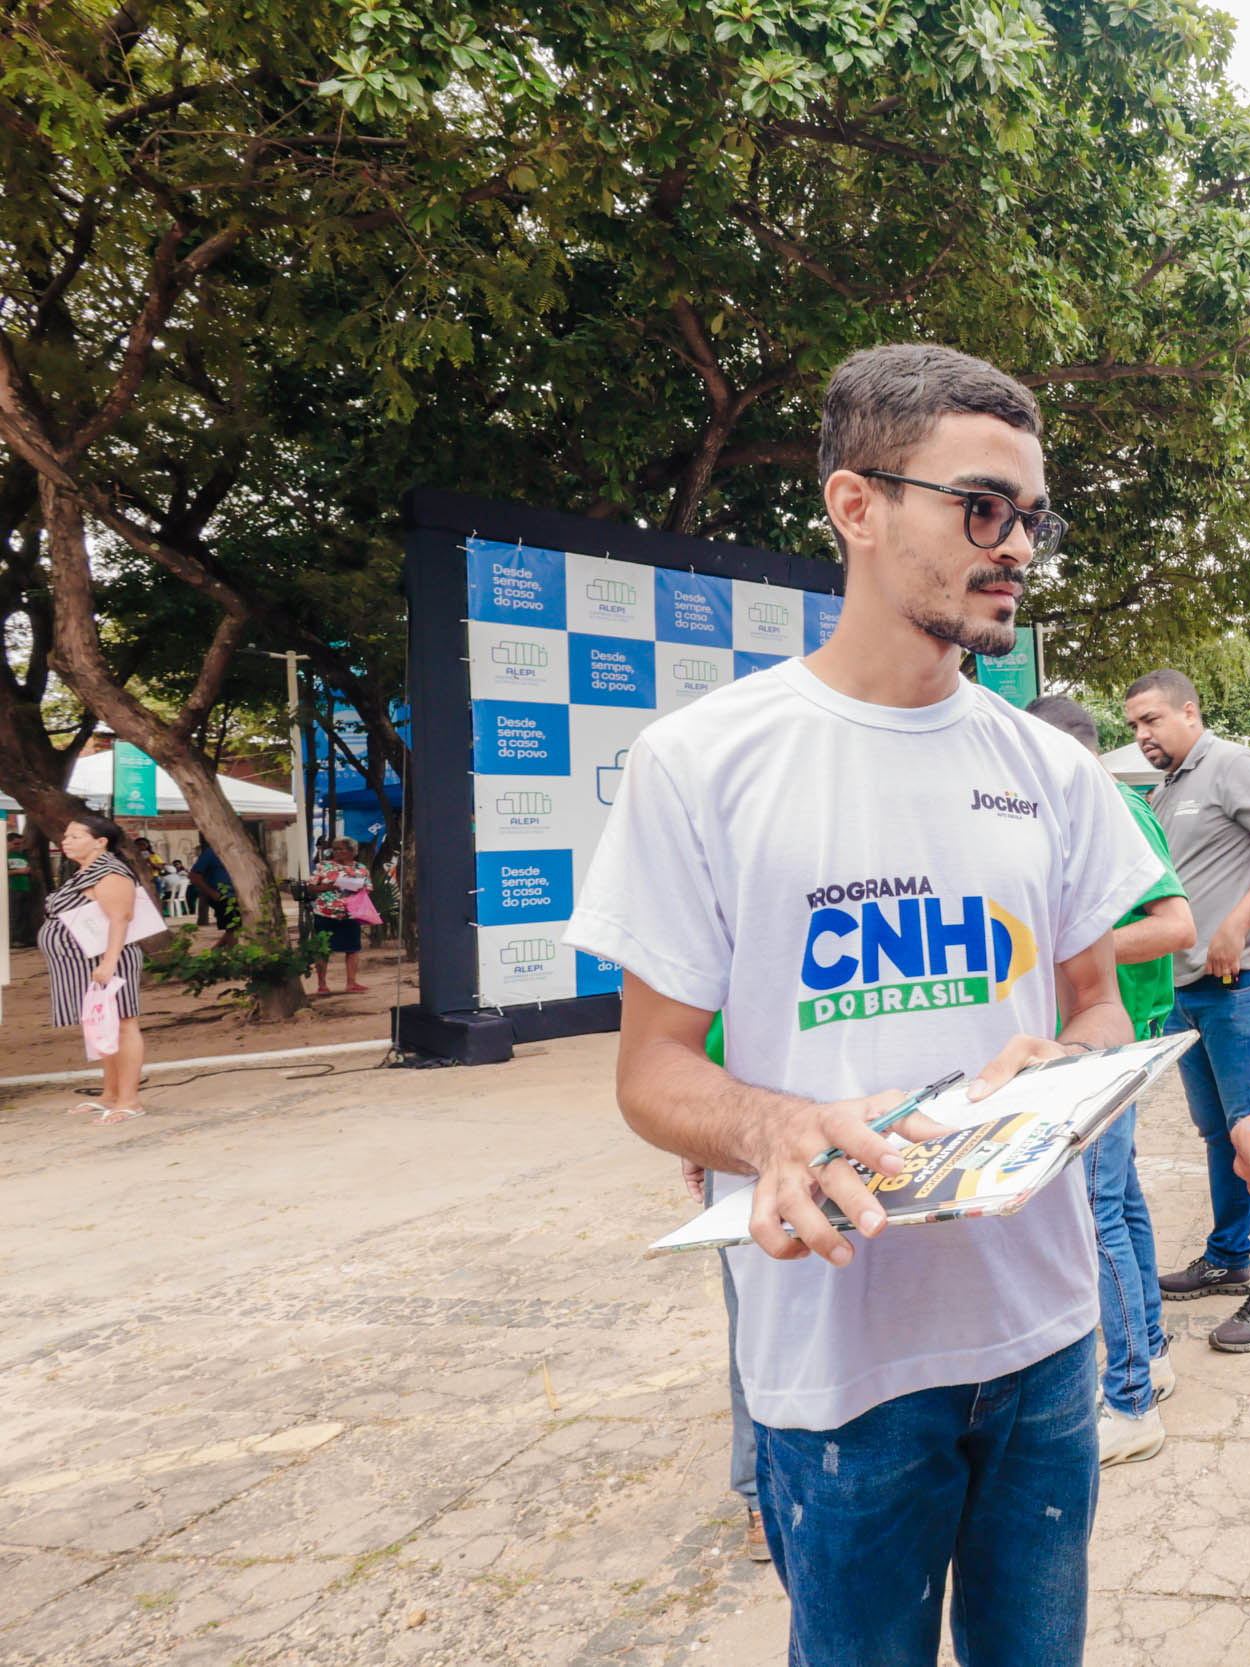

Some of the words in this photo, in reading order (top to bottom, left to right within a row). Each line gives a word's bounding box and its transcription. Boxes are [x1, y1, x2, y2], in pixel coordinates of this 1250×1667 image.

[493, 563, 533, 579] Desde
[493, 576, 542, 592] sempre,
[493, 586, 502, 595] a
[504, 587, 535, 599] casa
[674, 590, 706, 603] Desde
[493, 595, 511, 606] do
[513, 599, 544, 610] povo
[599, 604, 626, 614] ALEPI
[675, 611, 682, 619] a
[685, 612, 708, 621] casa
[675, 618, 689, 628] do
[690, 622, 715, 632] povo
[758, 624, 781, 634] ALEPI
[590, 649, 626, 662] Desde
[505, 667, 536, 677] ALEPI
[591, 660, 635, 674] sempre,
[591, 671, 599, 679] a
[601, 671, 628, 681] casa
[591, 679, 607, 690] do
[608, 682, 637, 692] povo
[684, 682, 709, 691] ALEPI
[497, 715, 537, 728] Desde
[497, 728, 546, 740] sempre,
[498, 739, 507, 747] a
[509, 739, 539, 748] casa
[498, 747, 515, 757] do
[517, 750, 548, 759] povo
[510, 817, 540, 825] ALEPI
[501, 866, 541, 877] Desde
[501, 876, 549, 888] sempre,
[502, 889, 510, 898] a
[512, 887, 542, 896] casa
[502, 897, 519, 907] do
[521, 896, 551, 908] povo
[801, 896, 988, 991] CNH
[514, 964, 544, 975] ALEPI
[814, 993, 856, 1024] DO
[863, 980, 975, 1016] BRASIL
